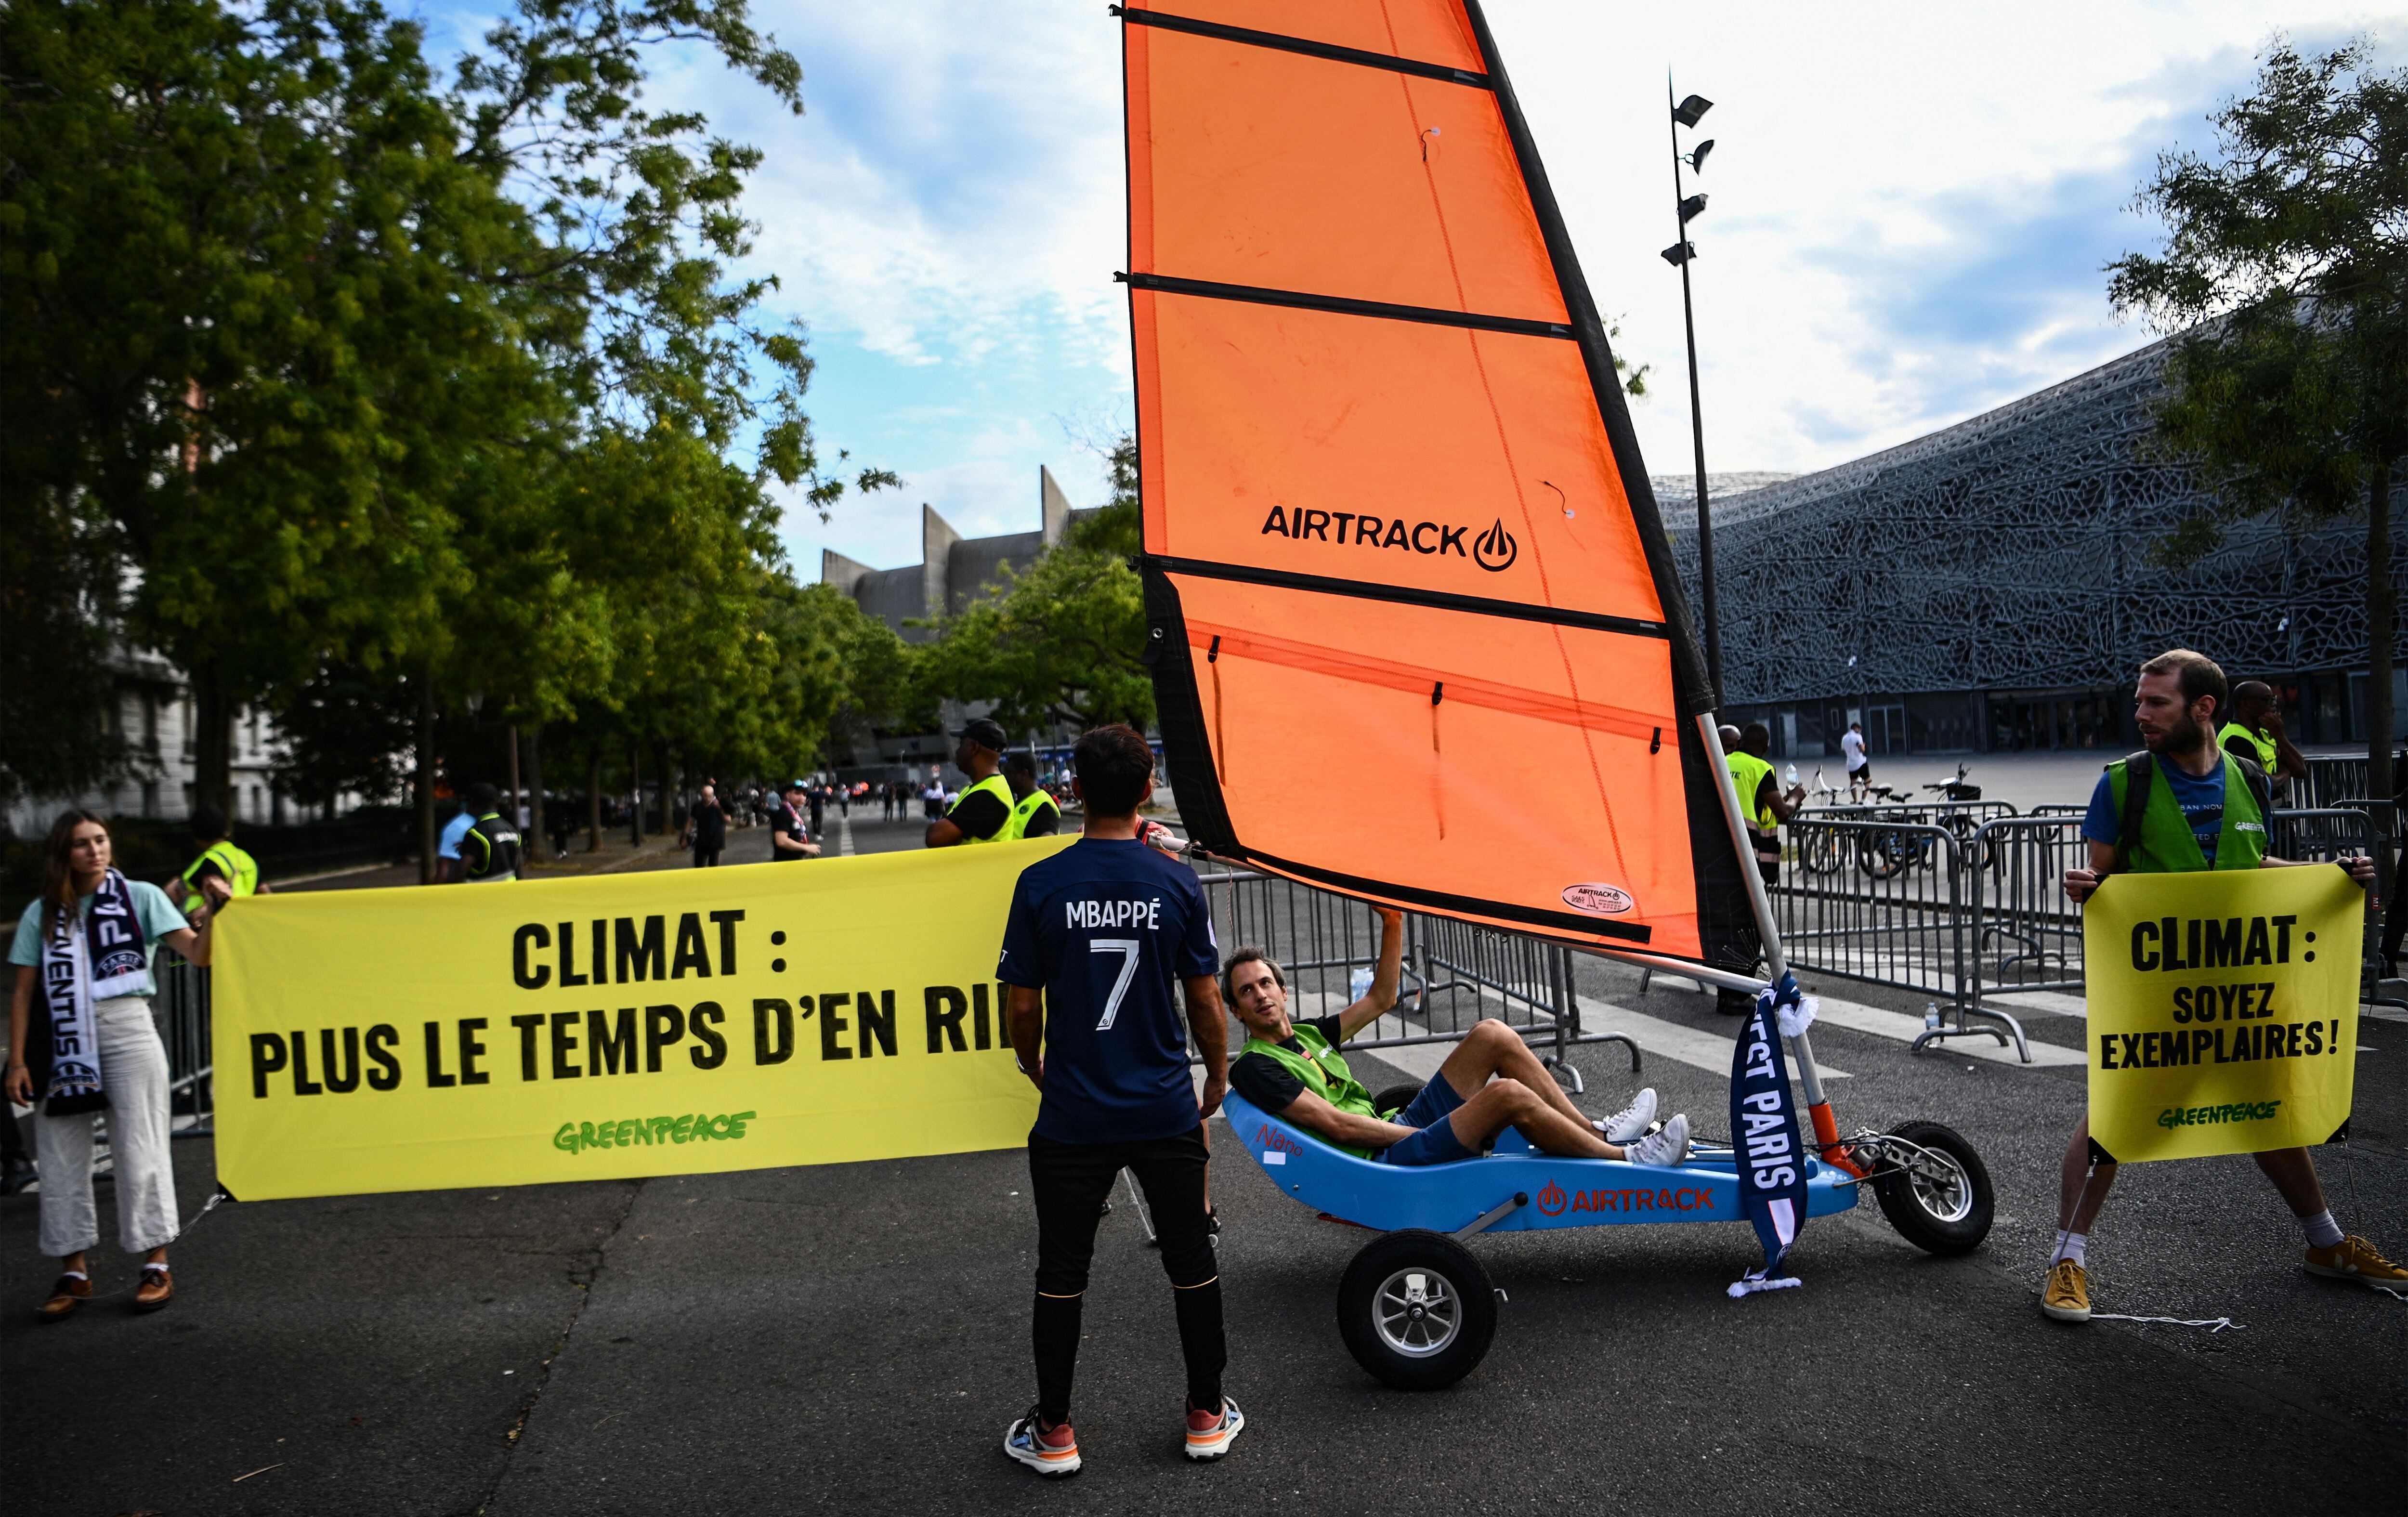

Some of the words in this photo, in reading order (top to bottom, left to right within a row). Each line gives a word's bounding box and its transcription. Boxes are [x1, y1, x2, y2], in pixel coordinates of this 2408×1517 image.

[1261, 506, 1468, 557] AIRTRACK
[1066, 898, 1161, 930] MBAPPÉ
[1578, 888, 1612, 898] AIRTRACK
[513, 909, 746, 990] CLIMAT
[771, 930, 787, 973] :
[1090, 939, 1139, 1031] 7
[2173, 982, 2275, 1024] SOYEZ
[249, 1023, 402, 1099] PLUS
[424, 1017, 490, 1088] LE
[511, 1001, 728, 1082] TEMPS
[753, 989, 899, 1066] D'EN
[554, 1111, 757, 1155] GREENPEACE
[2158, 1100, 2281, 1130] GREENPEACE
[1256, 1123, 1303, 1156] Nano
[1742, 1089, 1796, 1190] PARIS
[1571, 1187, 1714, 1212] AIRTRACK
